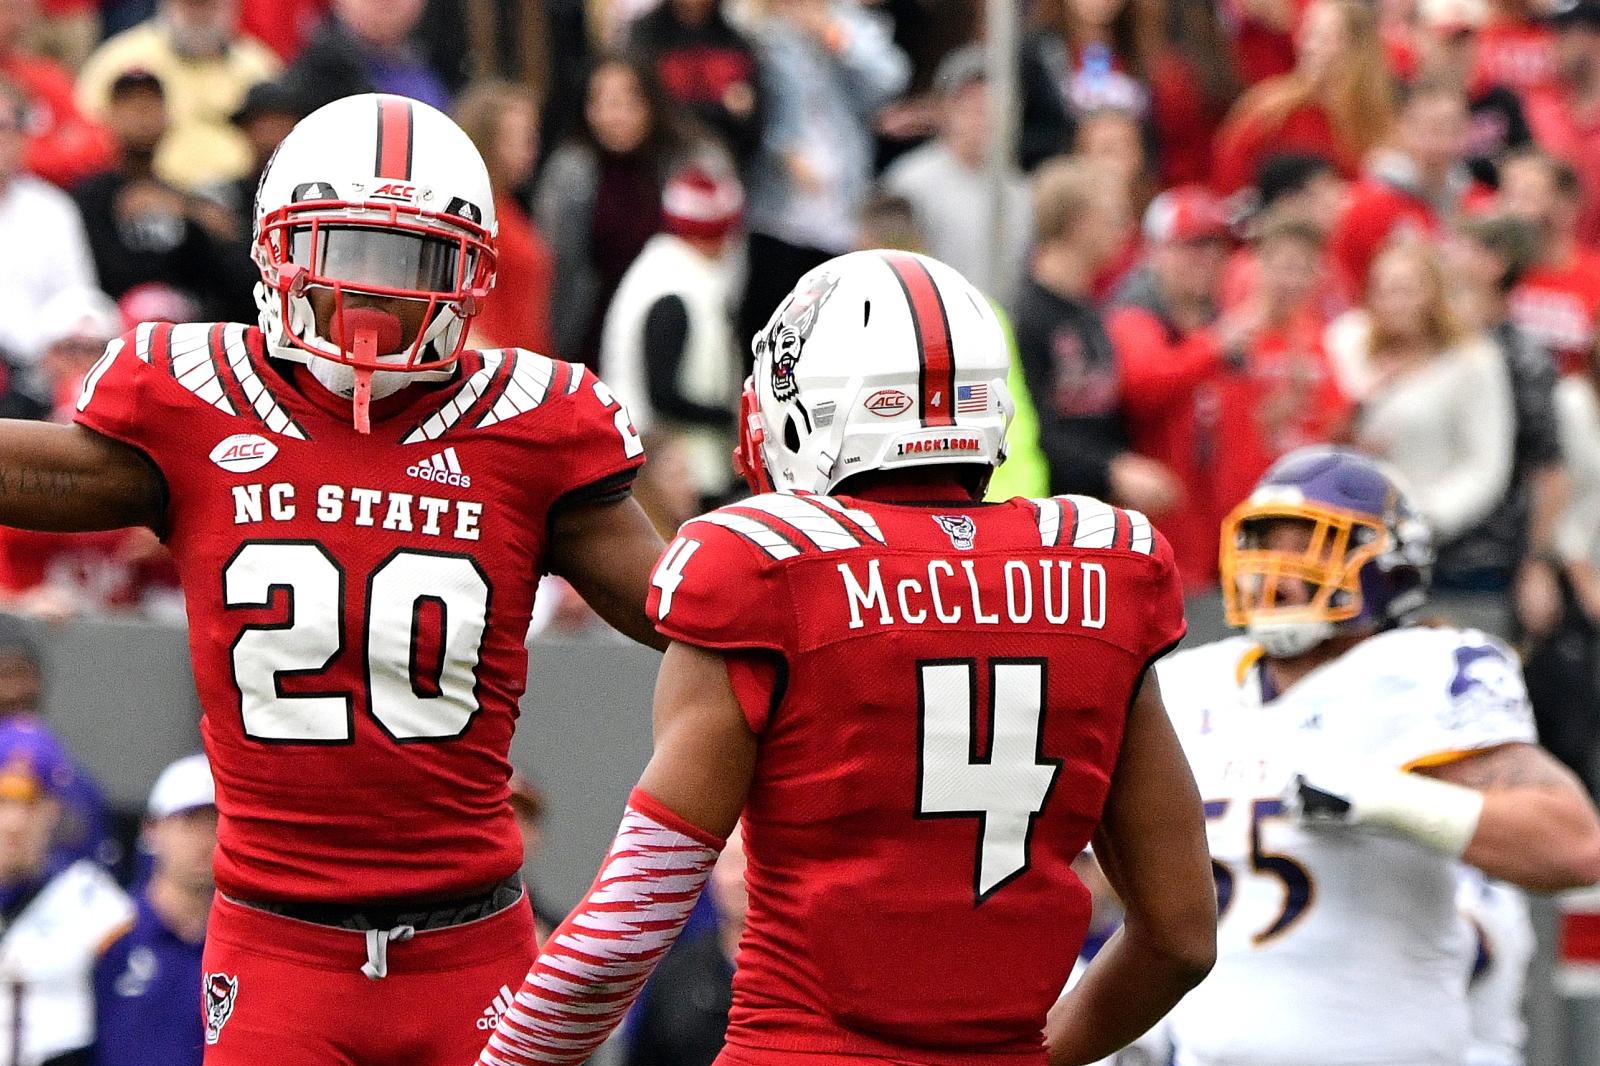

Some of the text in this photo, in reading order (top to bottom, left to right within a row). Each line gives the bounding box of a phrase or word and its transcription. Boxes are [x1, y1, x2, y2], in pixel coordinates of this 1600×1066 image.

[373, 183, 416, 198] ACC
[874, 395, 906, 409] ACC
[930, 391, 942, 408] 4
[220, 441, 266, 460] ACC
[406, 462, 473, 488] adidas
[231, 482, 484, 541] NC STATE
[652, 535, 701, 621] 4
[836, 558, 1109, 630] McCLOUD
[221, 538, 494, 746] 20
[915, 656, 1063, 904] 4
